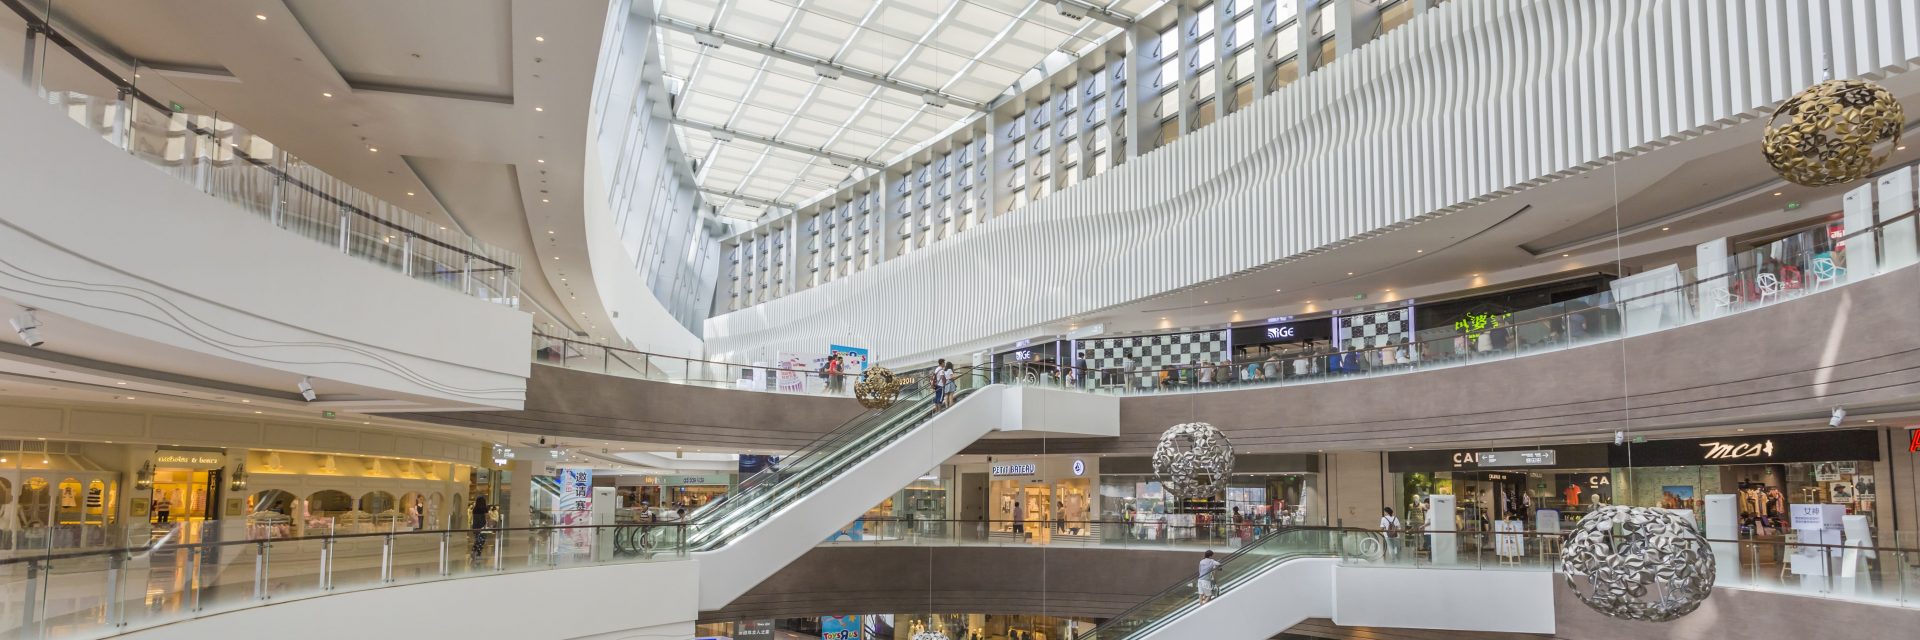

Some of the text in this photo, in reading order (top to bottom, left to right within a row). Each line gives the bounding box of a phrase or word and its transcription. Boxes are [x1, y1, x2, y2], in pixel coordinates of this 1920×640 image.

[992, 464, 1035, 474] PETIT BATEAU
[575, 472, 587, 512] 邀请赛
